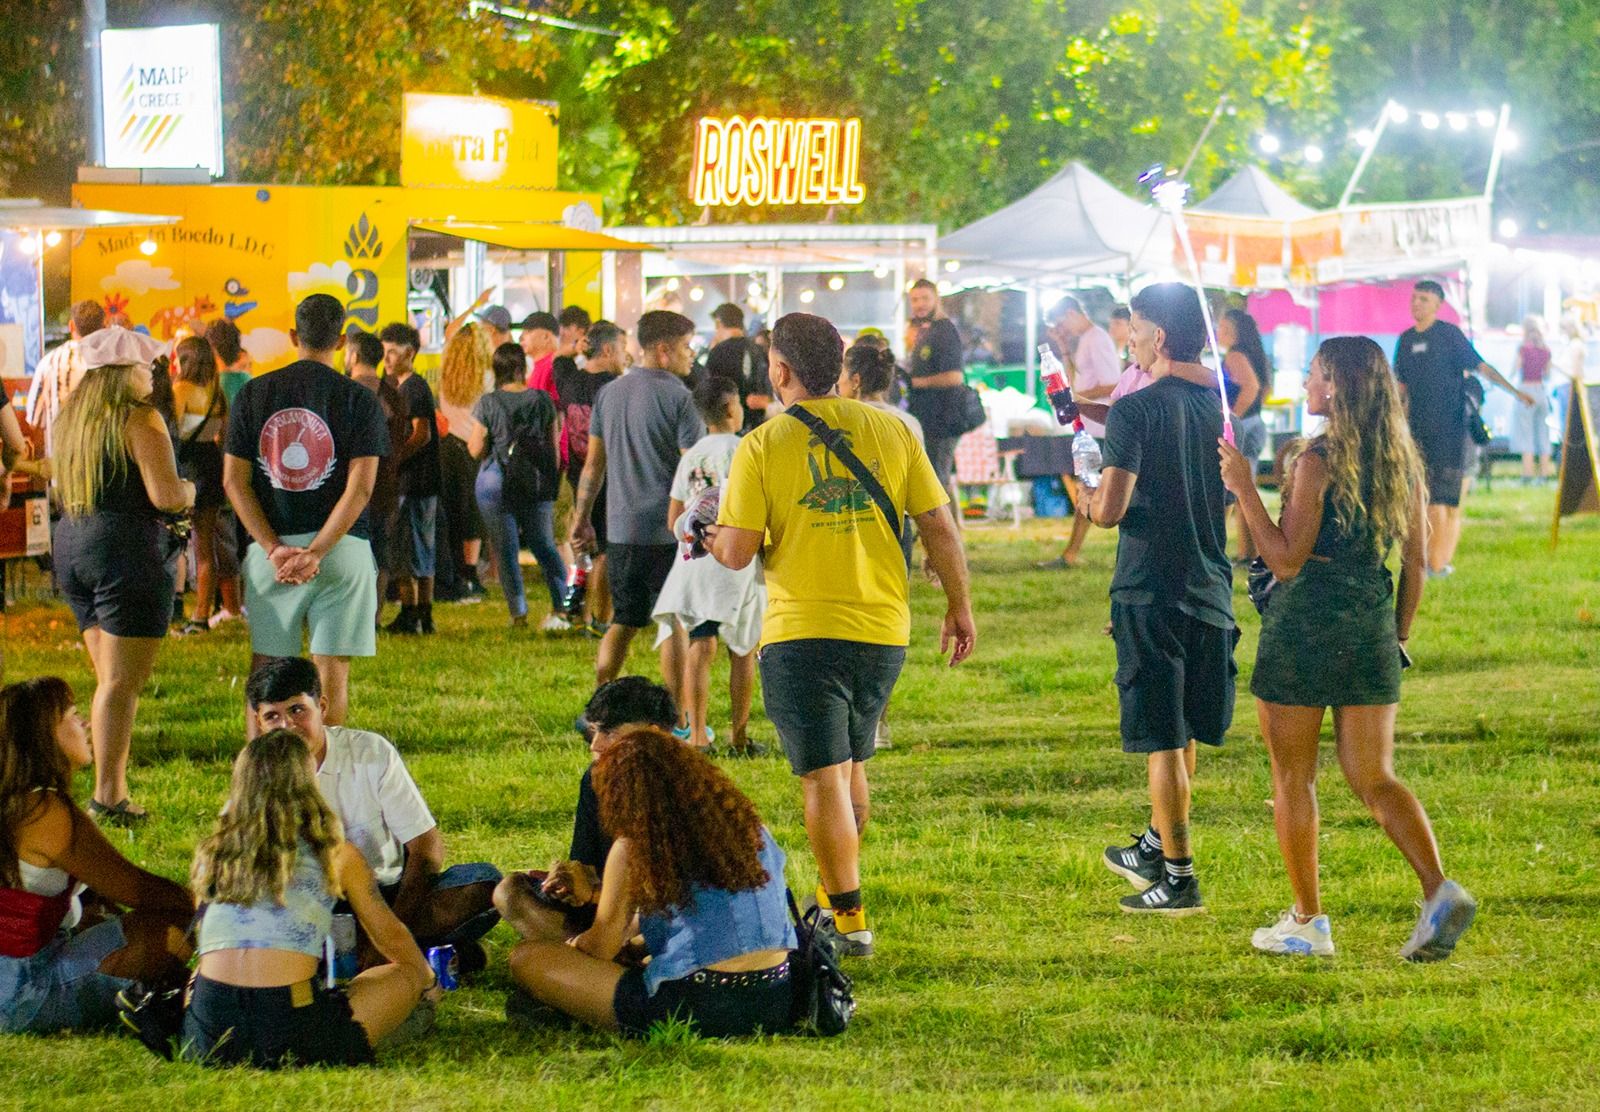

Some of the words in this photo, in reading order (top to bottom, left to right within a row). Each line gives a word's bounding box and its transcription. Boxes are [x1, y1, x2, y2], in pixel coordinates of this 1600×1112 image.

[139, 65, 195, 86] MAIP
[139, 93, 182, 108] CRECE
[694, 115, 866, 207] ROSWELL
[98, 230, 140, 256] Mad
[172, 227, 224, 245] Boedo
